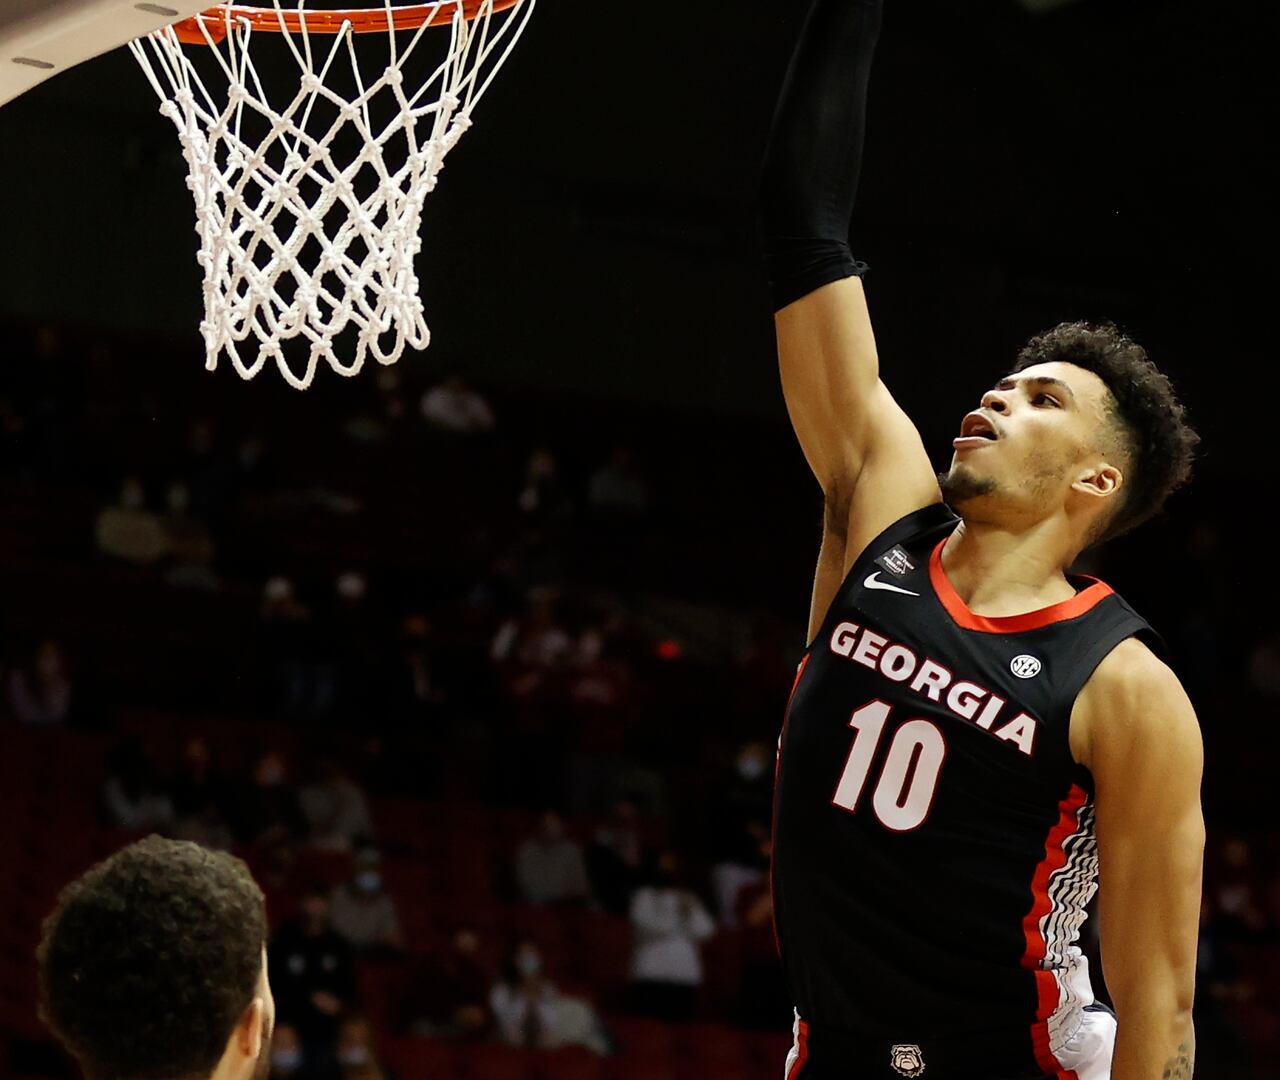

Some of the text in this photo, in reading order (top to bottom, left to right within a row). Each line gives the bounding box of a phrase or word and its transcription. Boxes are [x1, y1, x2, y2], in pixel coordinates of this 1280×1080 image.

[829, 620, 1038, 757] GEORGIA
[1012, 656, 1040, 678] SEC
[831, 699, 947, 832] 10
